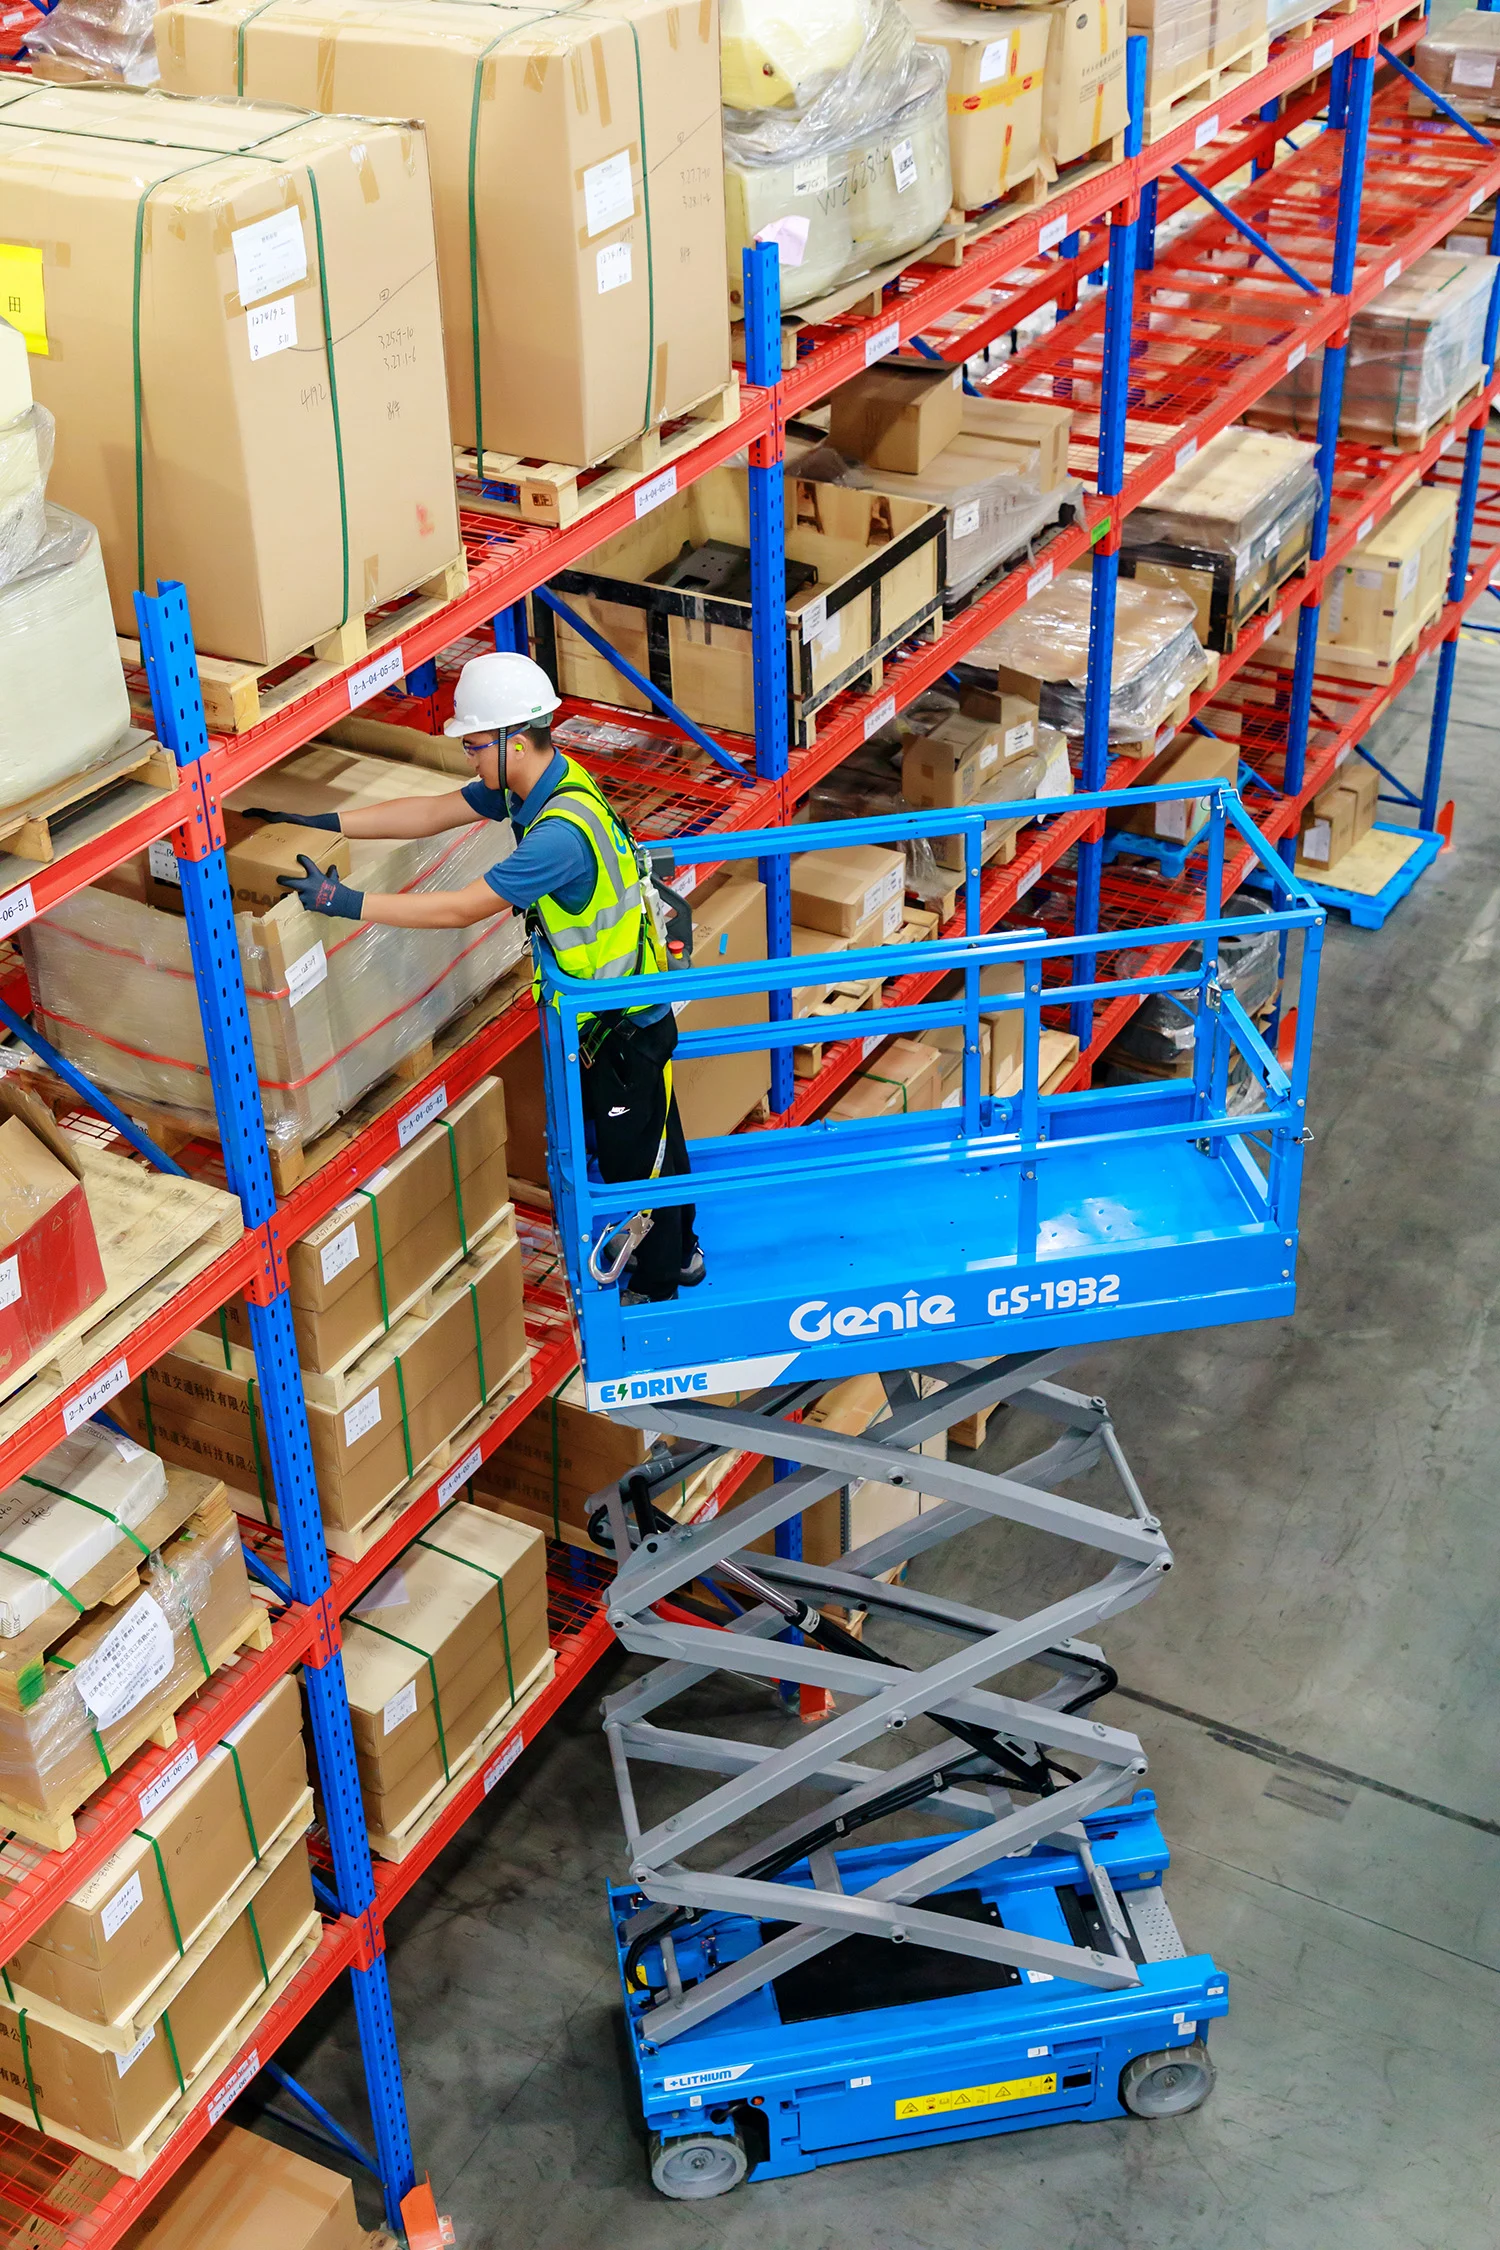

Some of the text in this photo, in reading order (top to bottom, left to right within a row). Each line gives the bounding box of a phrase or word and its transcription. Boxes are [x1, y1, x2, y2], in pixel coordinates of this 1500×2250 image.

[352, 656, 401, 697] 2-A-04-05-52
[987, 1273, 1121, 1318] GS-1932
[67, 1368, 124, 1422] 2-A-04-06-41
[145, 1751, 194, 1805] 2-A-04-06-31
